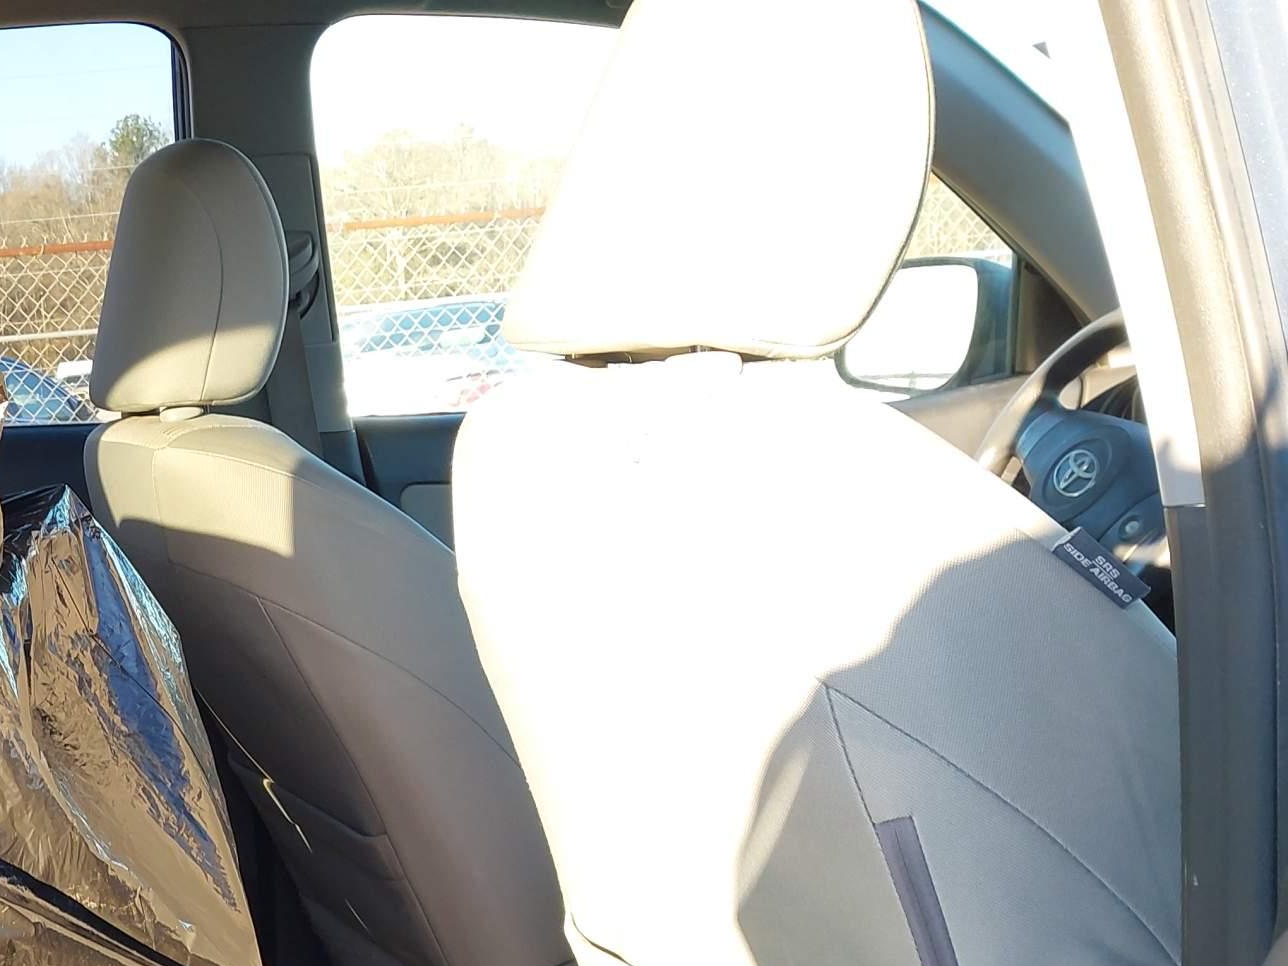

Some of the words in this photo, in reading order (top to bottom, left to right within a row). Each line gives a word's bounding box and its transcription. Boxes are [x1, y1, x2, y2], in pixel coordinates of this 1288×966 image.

[1063, 542, 1092, 568] SIDE
[1089, 566, 1133, 603] AIRBAG
[1095, 555, 1121, 579] SRS
